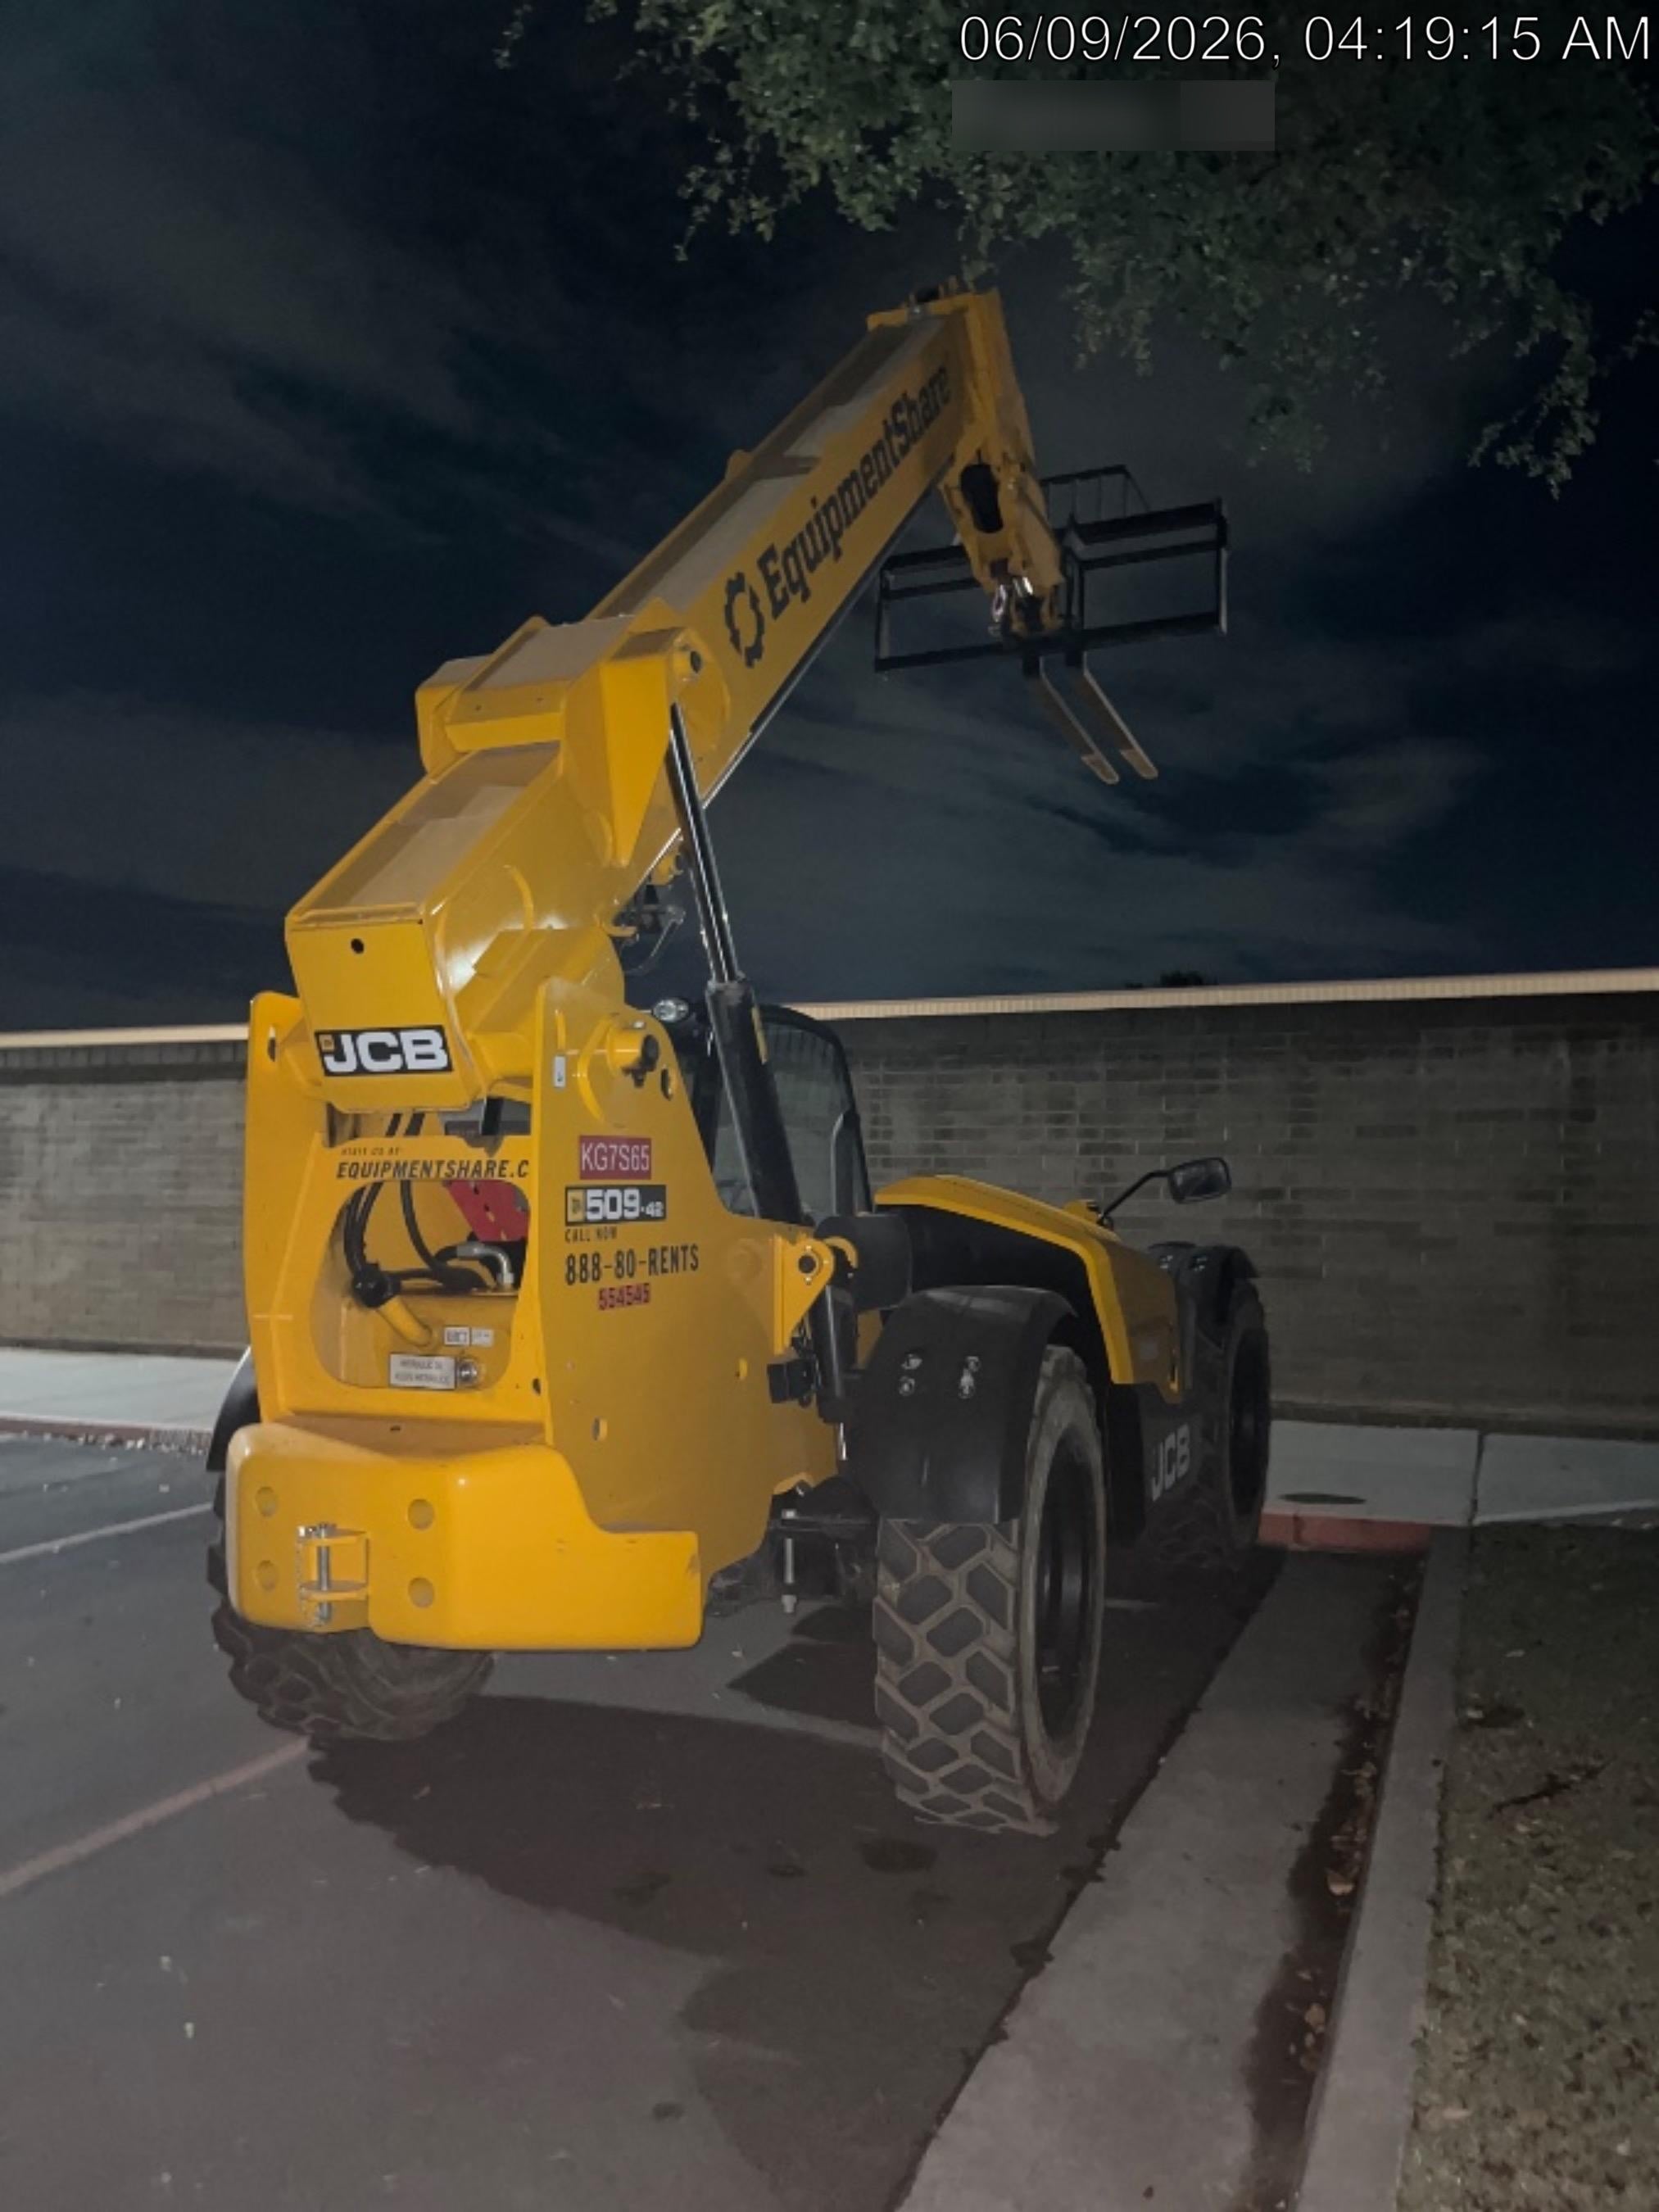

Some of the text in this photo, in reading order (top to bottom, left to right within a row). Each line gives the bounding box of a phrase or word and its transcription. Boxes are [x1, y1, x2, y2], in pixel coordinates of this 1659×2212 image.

[756, 366, 952, 620] EquipmentShare
[321, 1028, 449, 1073] JCB
[581, 1142, 650, 1172] KG7S65
[565, 1243, 699, 1286] 888-80-RENTS
[1151, 1423, 1190, 1502] JCB
